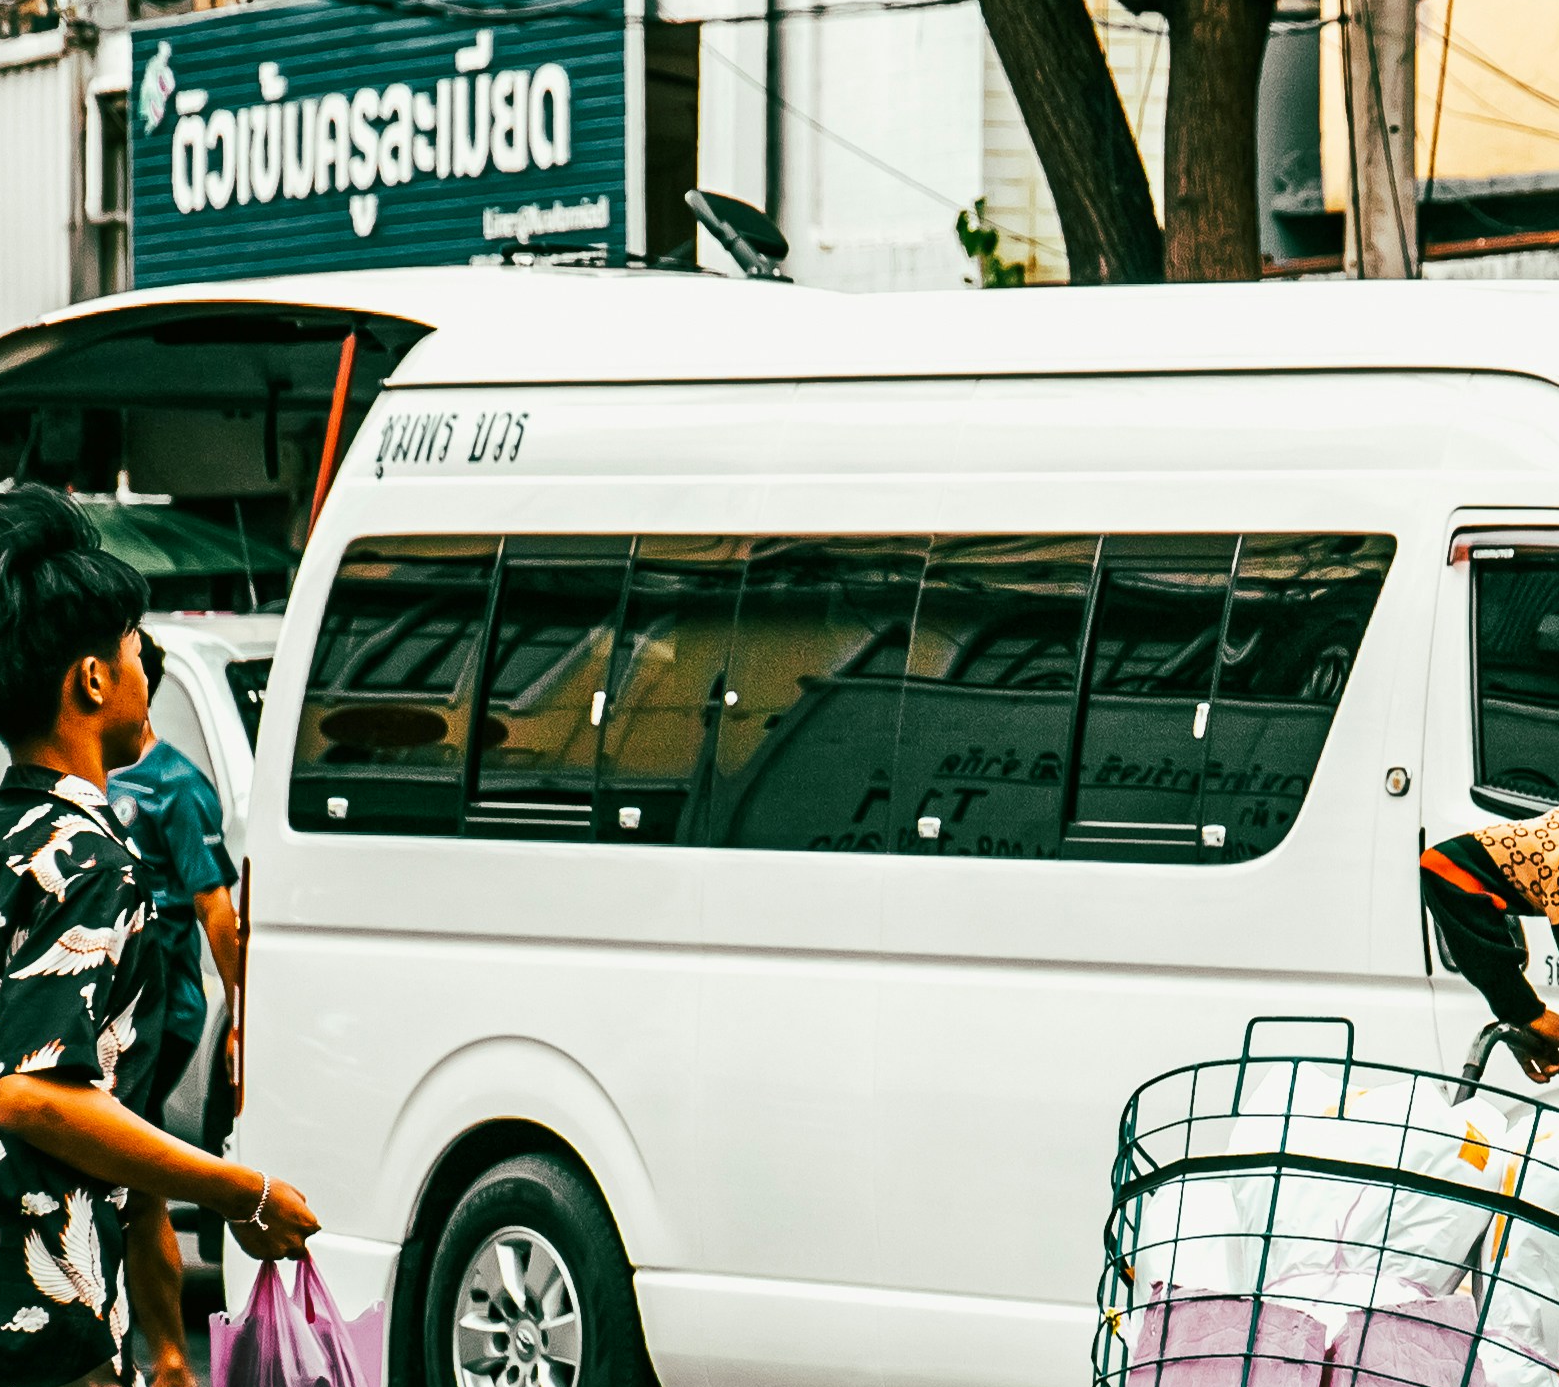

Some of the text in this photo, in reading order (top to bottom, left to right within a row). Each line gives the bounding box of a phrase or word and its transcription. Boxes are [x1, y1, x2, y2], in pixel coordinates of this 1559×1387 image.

[171, 29, 571, 237] ติวเข้มครูละเมียด
[467, 412, 529, 462] บวร
